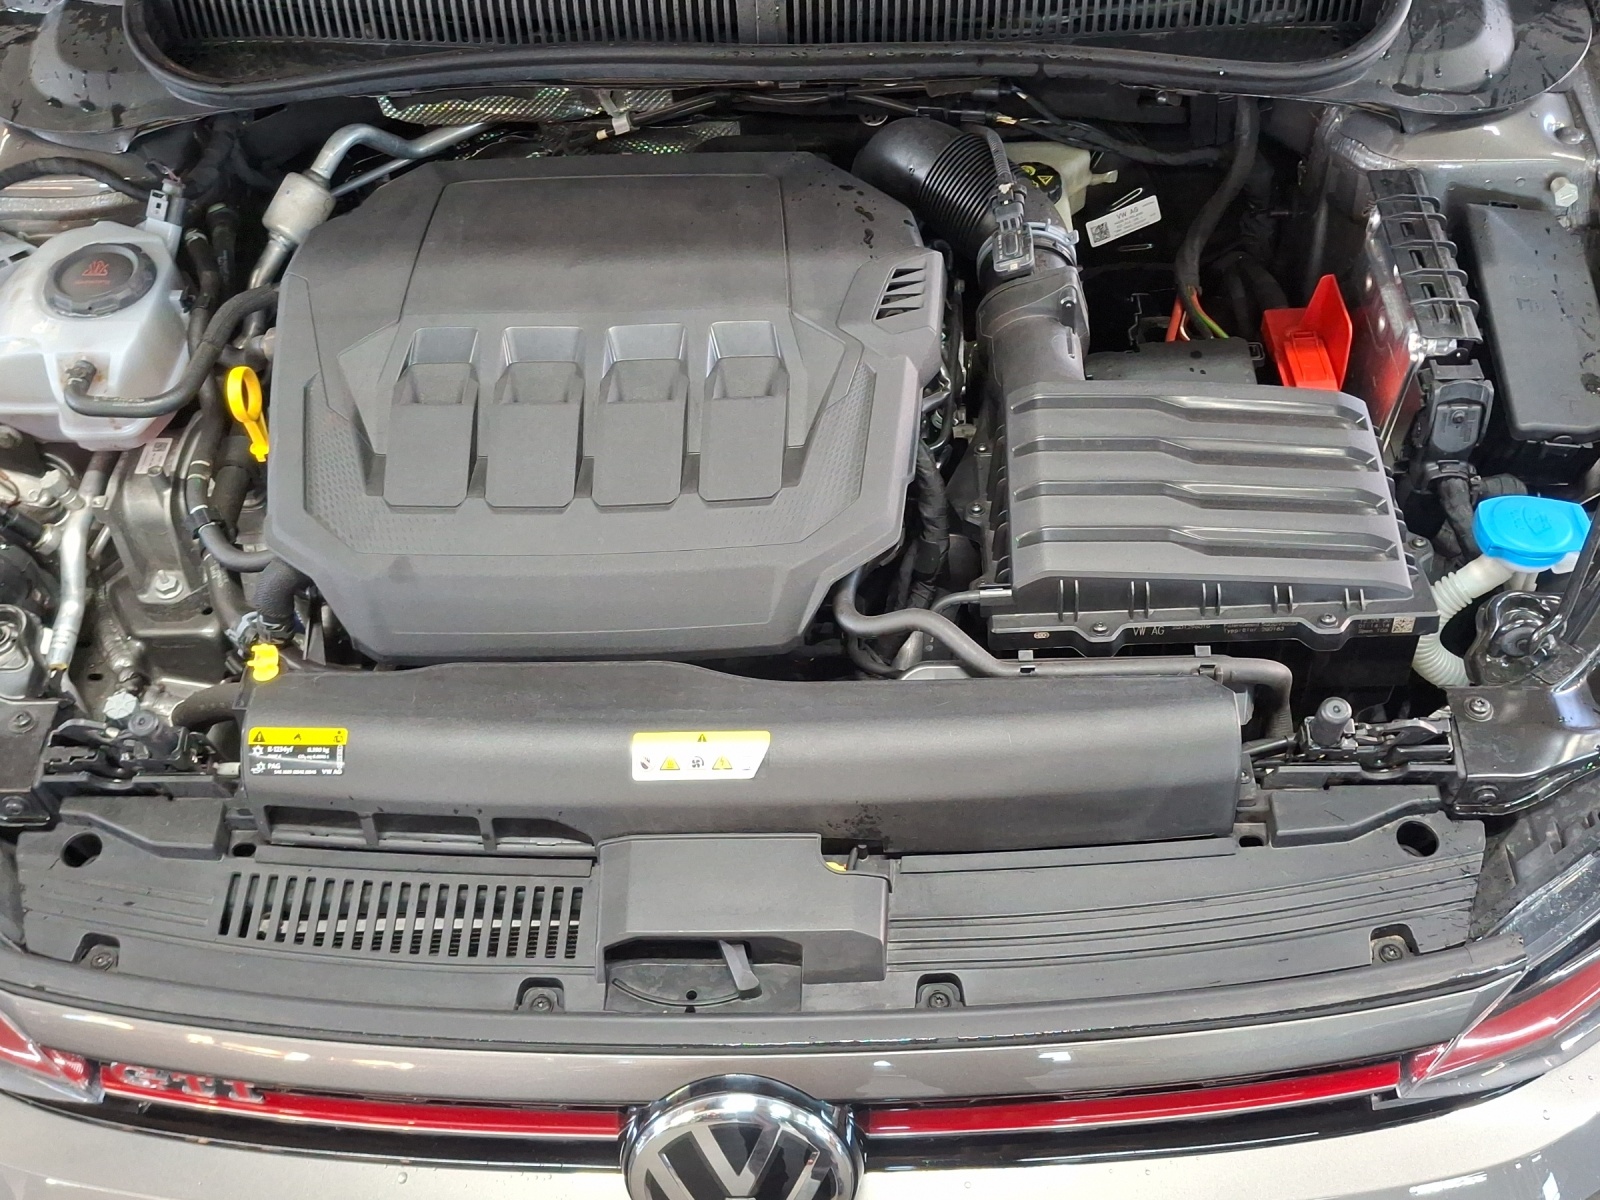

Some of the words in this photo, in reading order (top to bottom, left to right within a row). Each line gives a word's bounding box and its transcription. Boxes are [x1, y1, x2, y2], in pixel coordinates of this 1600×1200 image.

[1116, 211, 1127, 219] VW
[1130, 206, 1139, 215] AG
[1132, 625, 1146, 636] VW
[1151, 625, 1165, 636] AG
[110, 1061, 265, 1105] GTI
